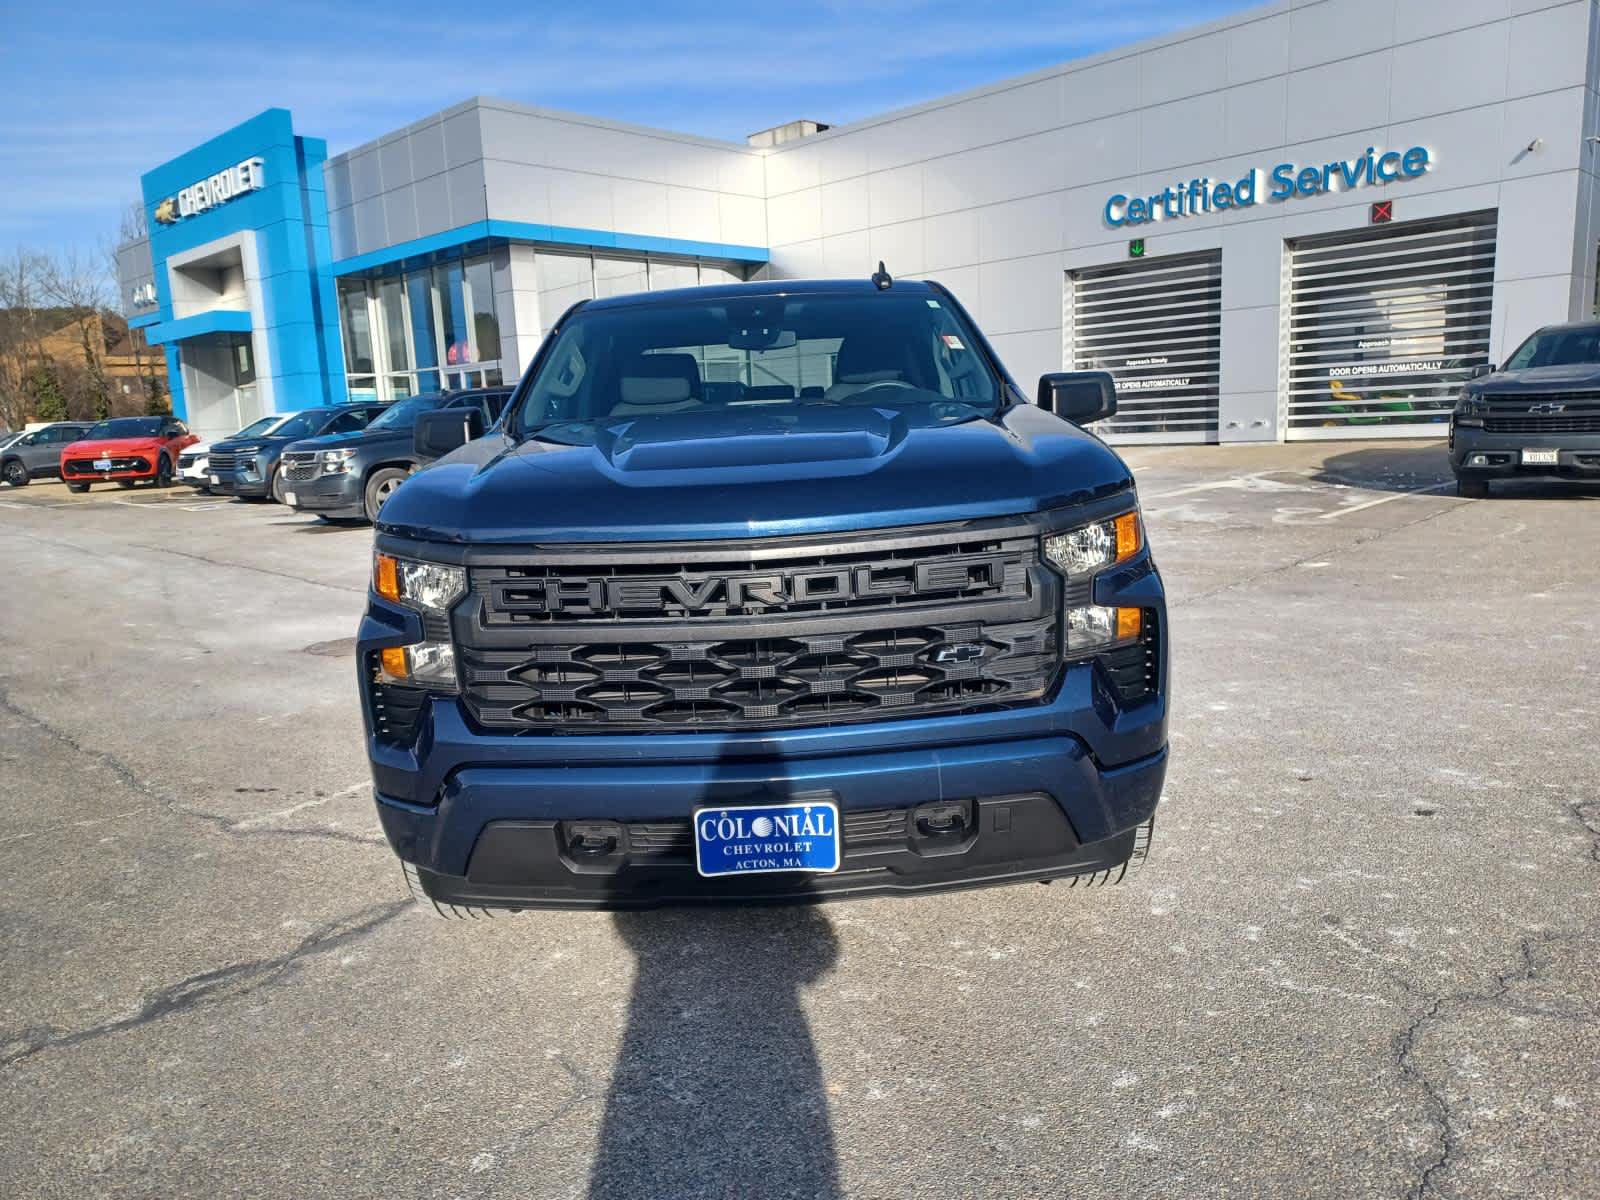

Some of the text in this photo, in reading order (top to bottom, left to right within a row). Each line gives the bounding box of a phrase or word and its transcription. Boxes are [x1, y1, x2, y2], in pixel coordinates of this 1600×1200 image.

[178, 157, 264, 217] CHEVROLET
[1105, 146, 1430, 226] Certified Service
[1329, 361, 1442, 376] DOOR OPENS AUTOMATICALLY
[1122, 381, 1140, 389] OPENS
[1141, 378, 1190, 388] AUTOMATICALLY
[491, 551, 1022, 613] CHEVROLET
[701, 812, 832, 841] COLONIAL
[723, 841, 812, 856] CHEVROLET
[735, 858, 801, 870] ACTON, MA
